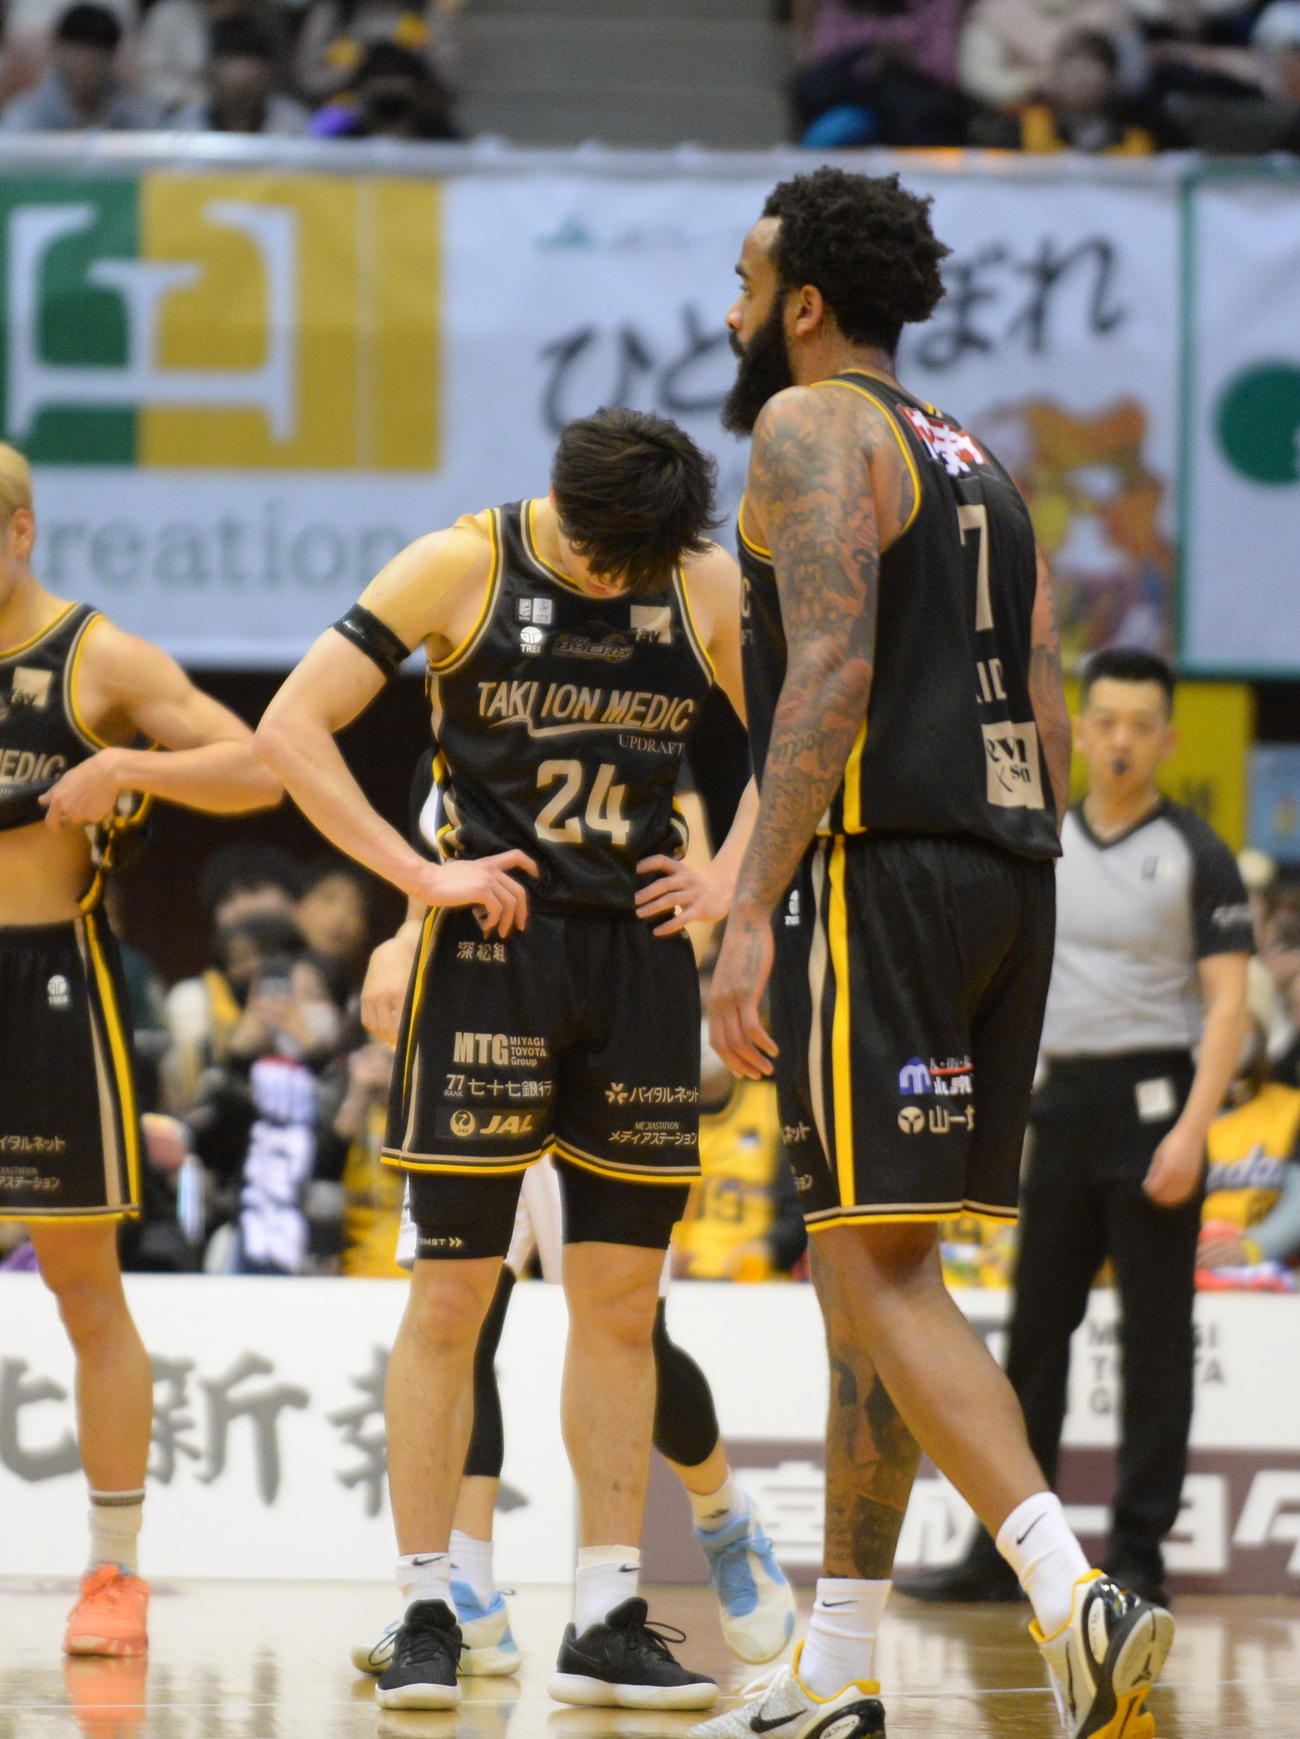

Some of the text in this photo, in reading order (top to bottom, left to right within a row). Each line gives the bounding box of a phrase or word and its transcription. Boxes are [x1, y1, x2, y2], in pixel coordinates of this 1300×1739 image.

[957, 504, 994, 631] 7
[601, 690, 695, 733] MEDIC
[618, 734, 686, 756] UPDRAFT
[0, 749, 66, 784] EDIC
[534, 759, 630, 845] 24
[453, 1032, 509, 1065] MTG
[510, 1036, 544, 1047] MIYAGI
[511, 1047, 547, 1057] TOYOTA
[511, 1057, 539, 1067] Group
[446, 1074, 466, 1090] 77
[467, 1078, 553, 1097] 七十七銀行
[629, 1086, 699, 1103] バイタルネット
[479, 1114, 533, 1135] JAL
[608, 1131, 697, 1145] メディアステーション
